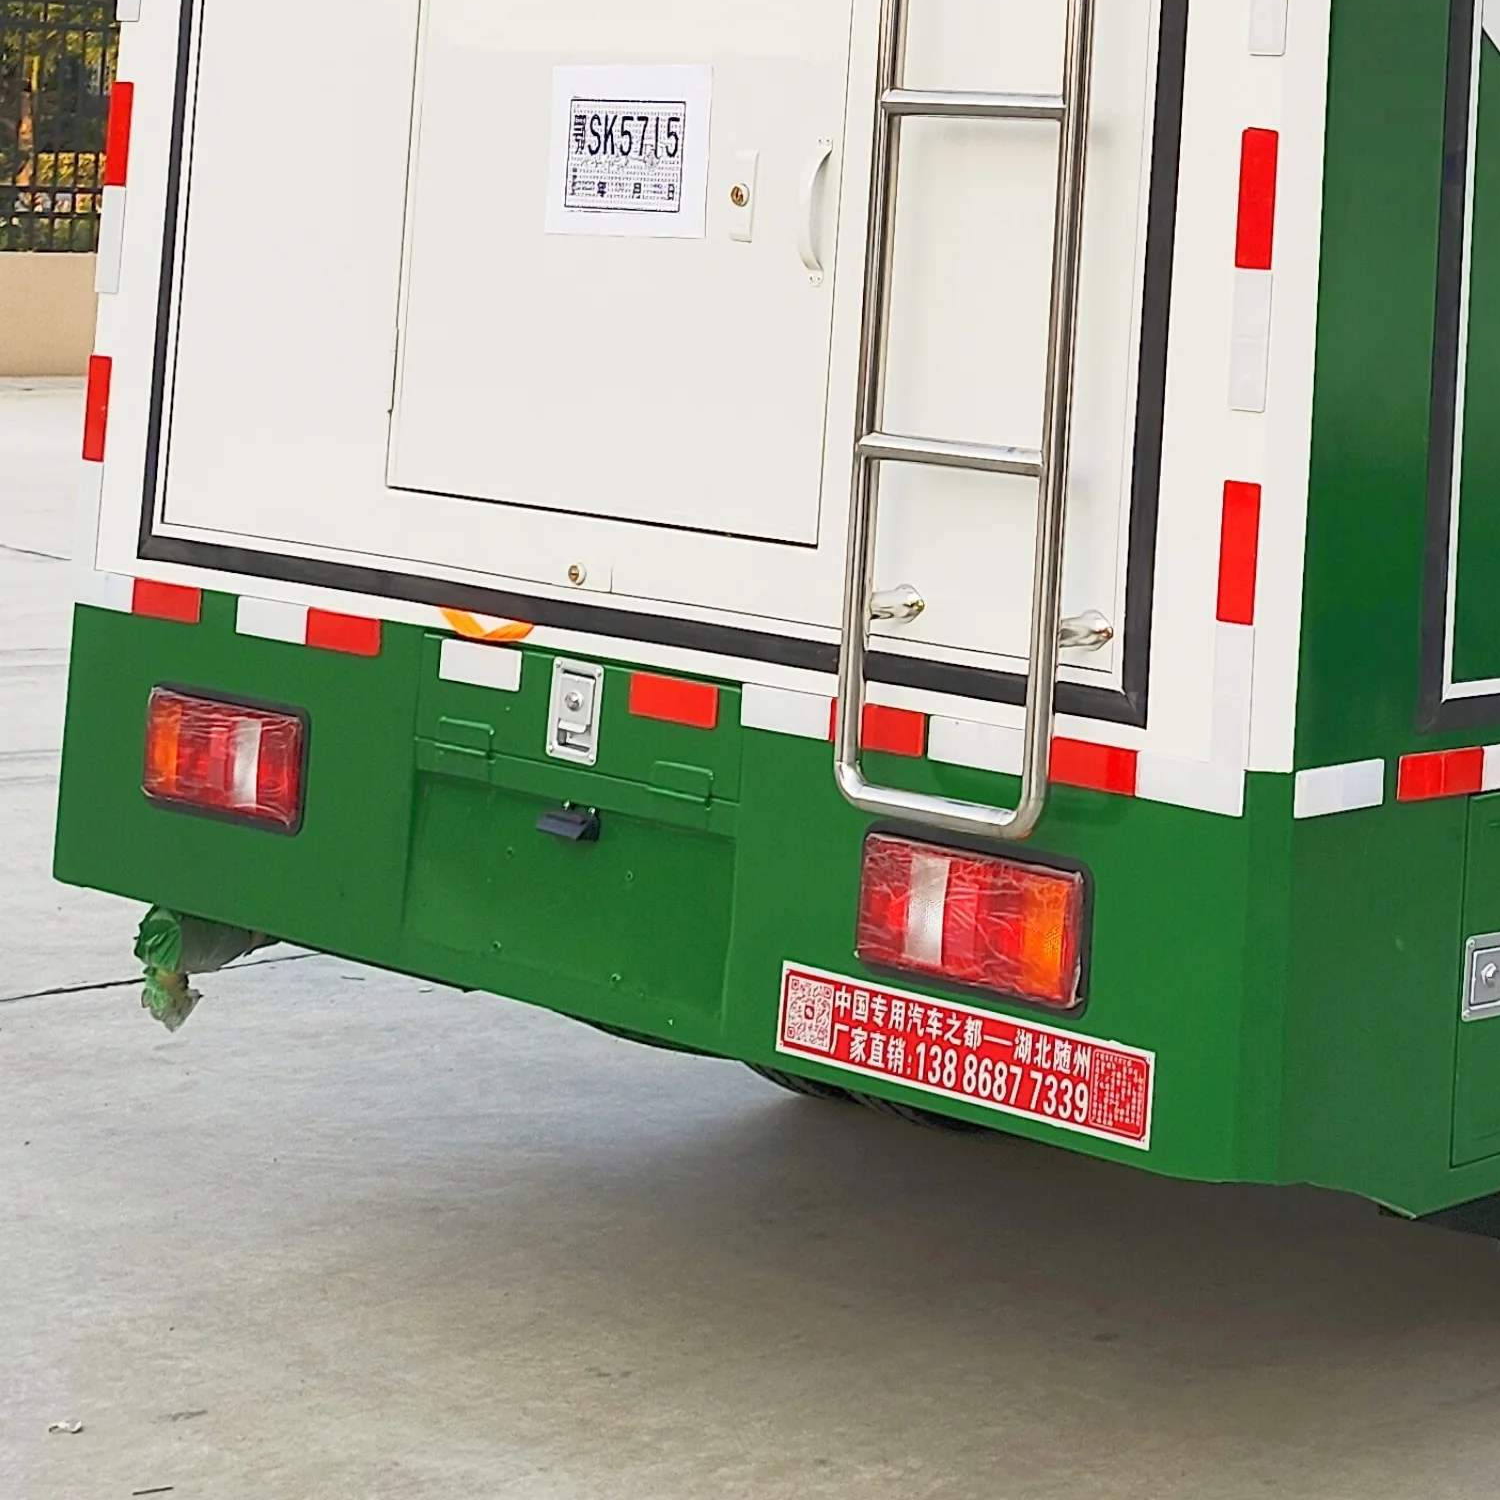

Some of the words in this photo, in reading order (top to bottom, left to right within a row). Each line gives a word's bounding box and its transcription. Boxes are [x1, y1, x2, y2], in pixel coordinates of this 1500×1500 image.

[915, 1041, 959, 1088] 138
[962, 1053, 1023, 1105] 8687
[1029, 1070, 1089, 1123] 7339
